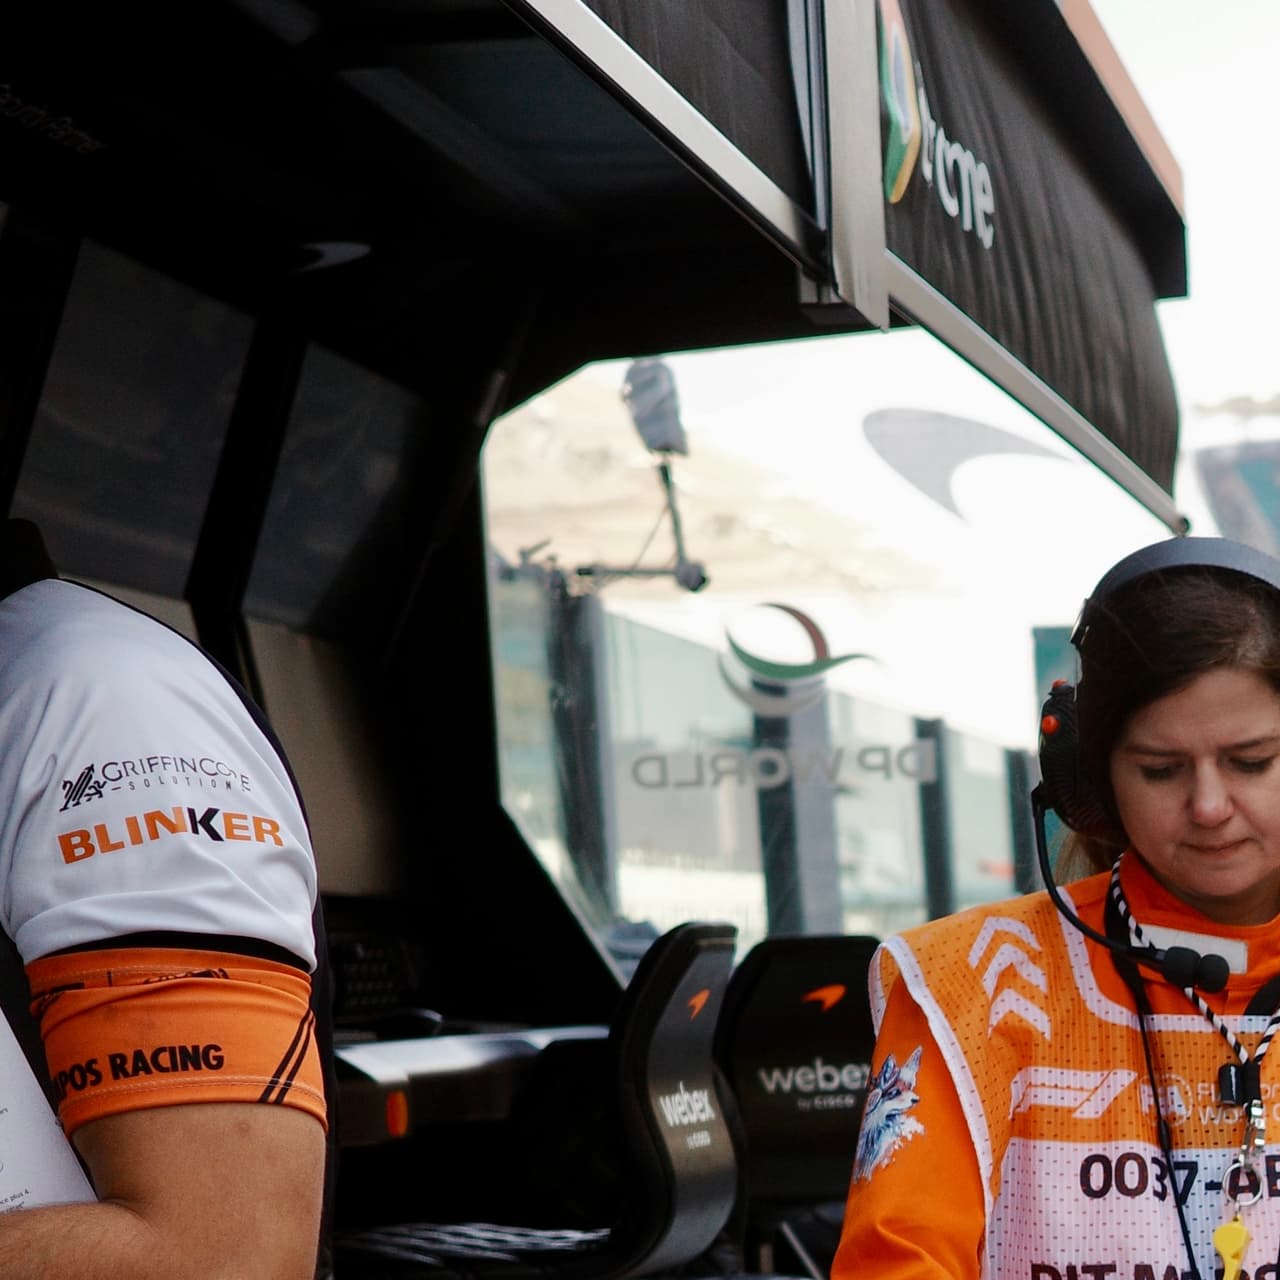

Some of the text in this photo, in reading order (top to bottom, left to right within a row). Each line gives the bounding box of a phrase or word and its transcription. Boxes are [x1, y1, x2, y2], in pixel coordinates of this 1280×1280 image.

[102, 755, 250, 789] GRIFFINCOE
[58, 806, 284, 864] BLINKER
[107, 1044, 225, 1080] RACING
[660, 1080, 716, 1128] webex
